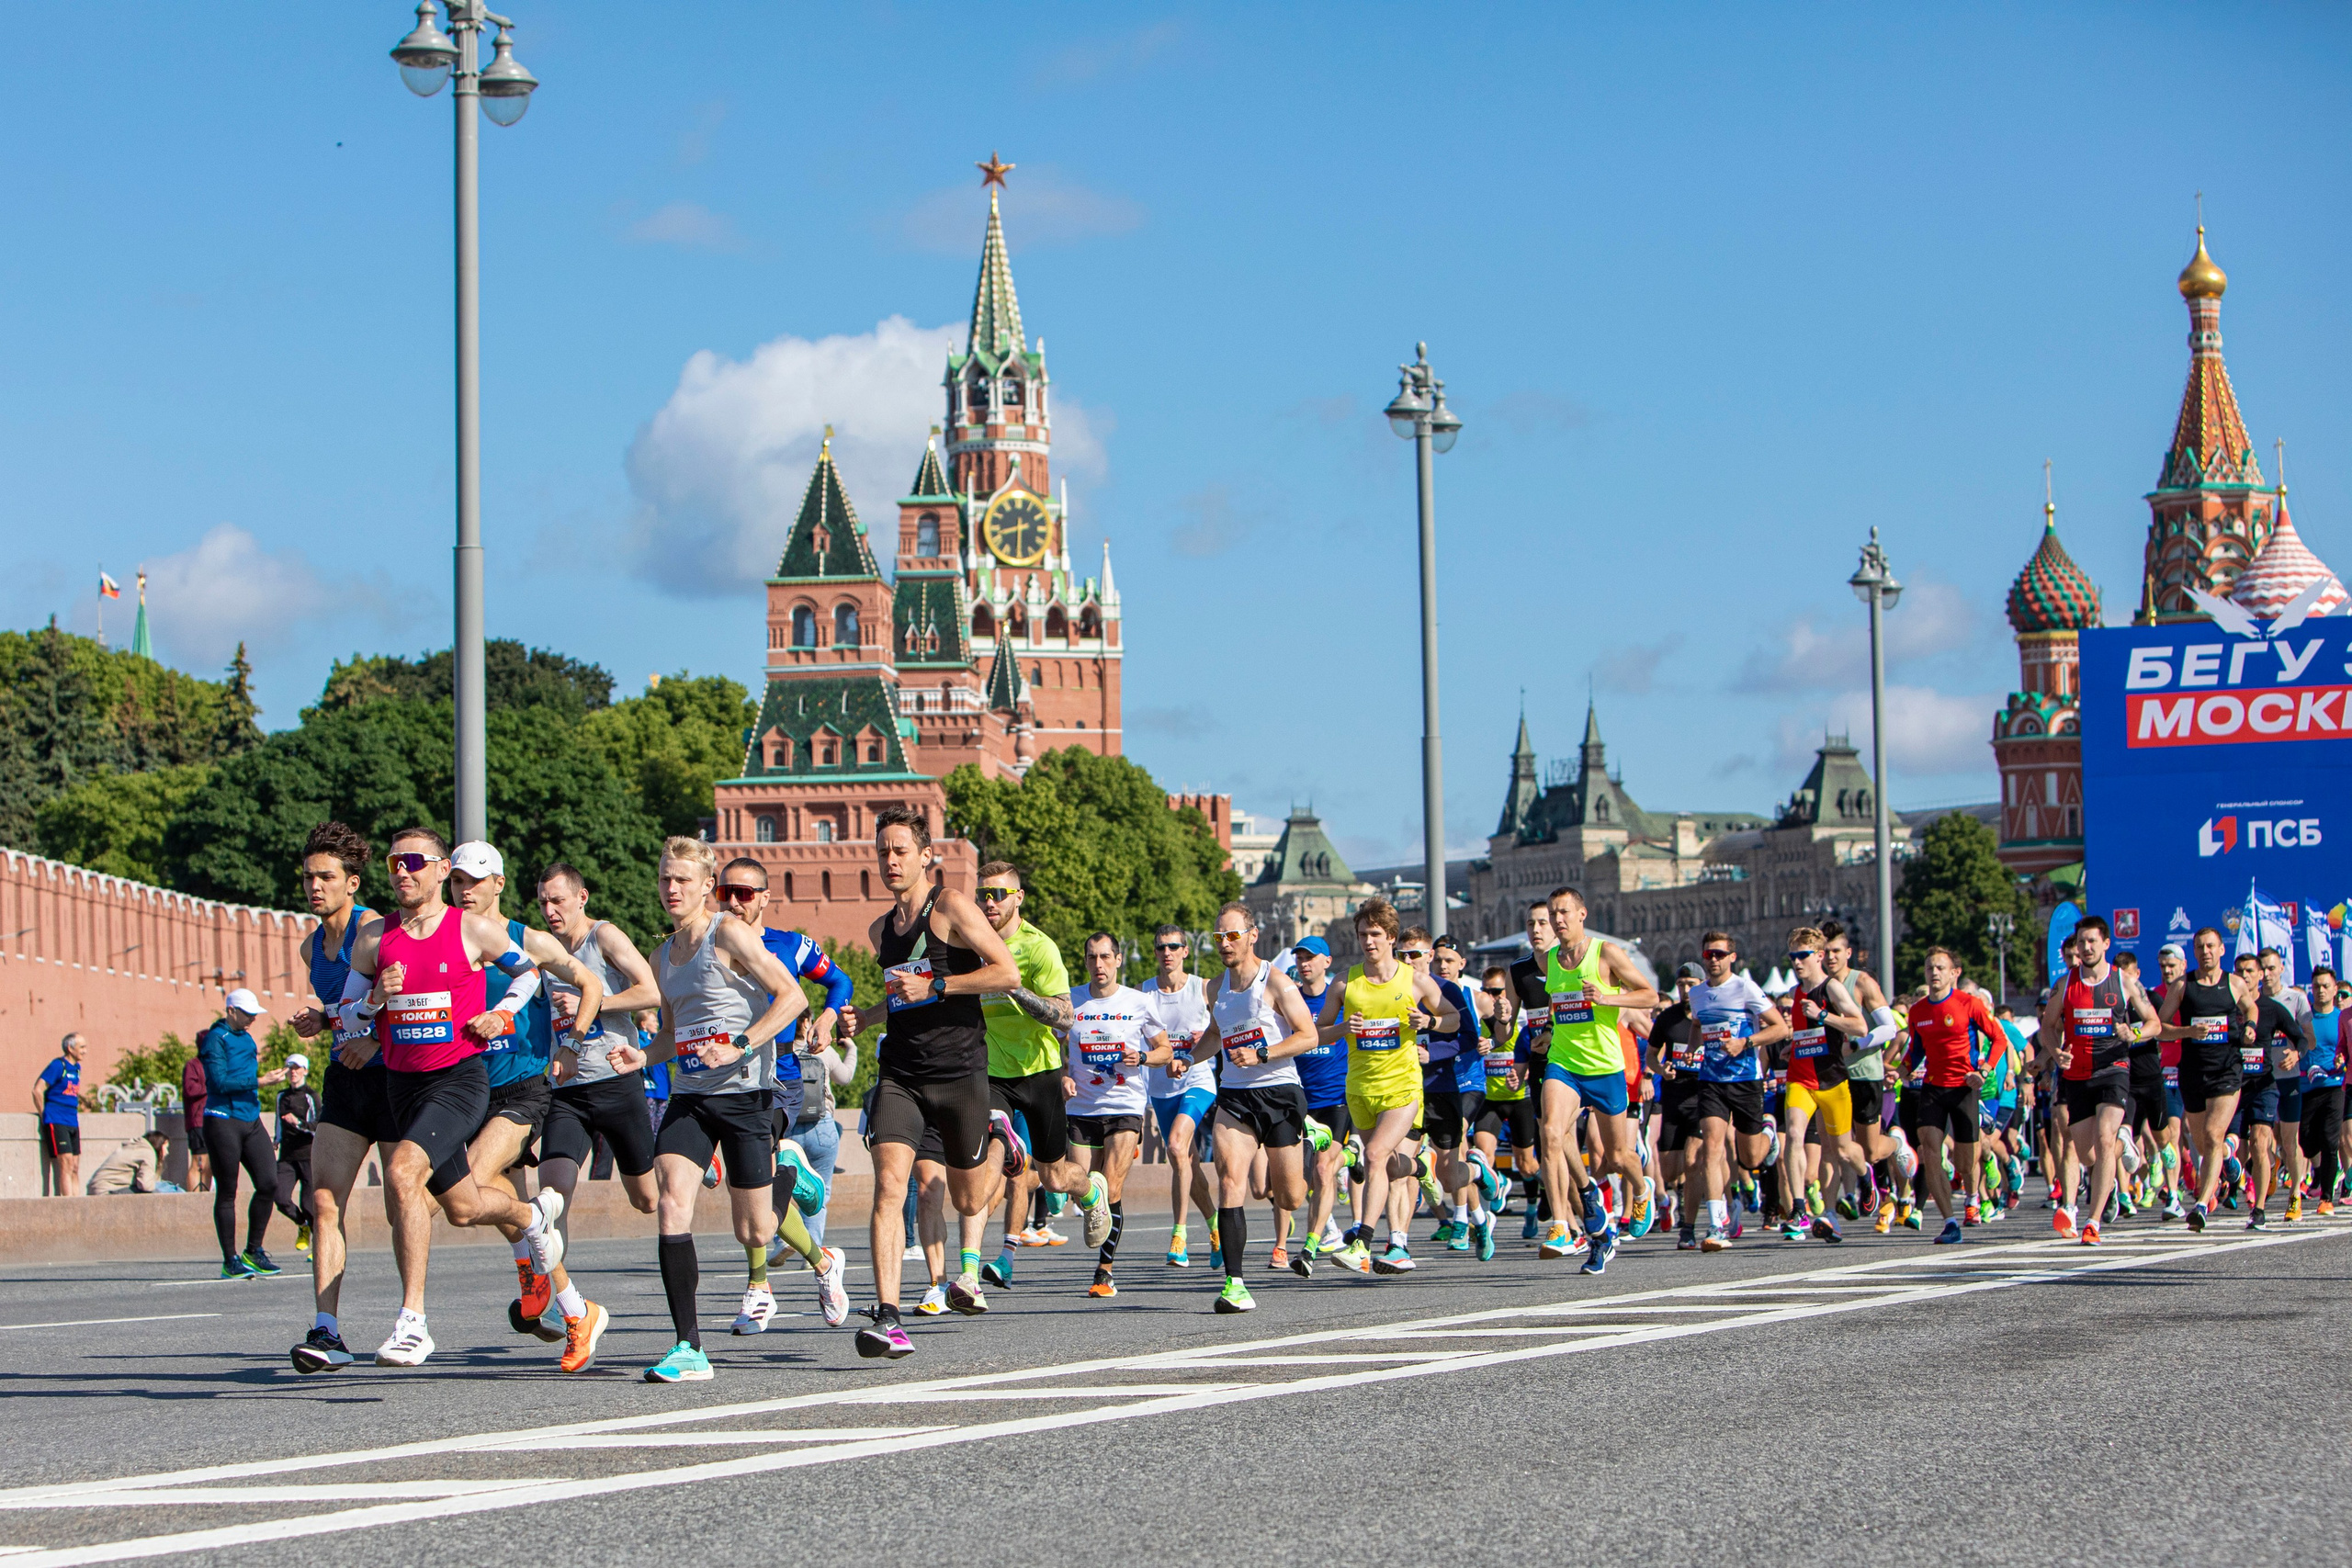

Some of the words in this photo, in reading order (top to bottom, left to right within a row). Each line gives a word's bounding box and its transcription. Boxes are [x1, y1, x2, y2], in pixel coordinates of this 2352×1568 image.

[2125, 639, 2324, 689] БЕГУ
[2137, 691, 2352, 739] МОСК
[2248, 818, 2323, 849] ПСБ
[1558, 1012, 1589, 1021] 11085
[396, 1026, 447, 1040] 15528
[1361, 1039, 1396, 1048] 13425
[1798, 1046, 1823, 1055] 11289
[1088, 1054, 1120, 1062] 11647
